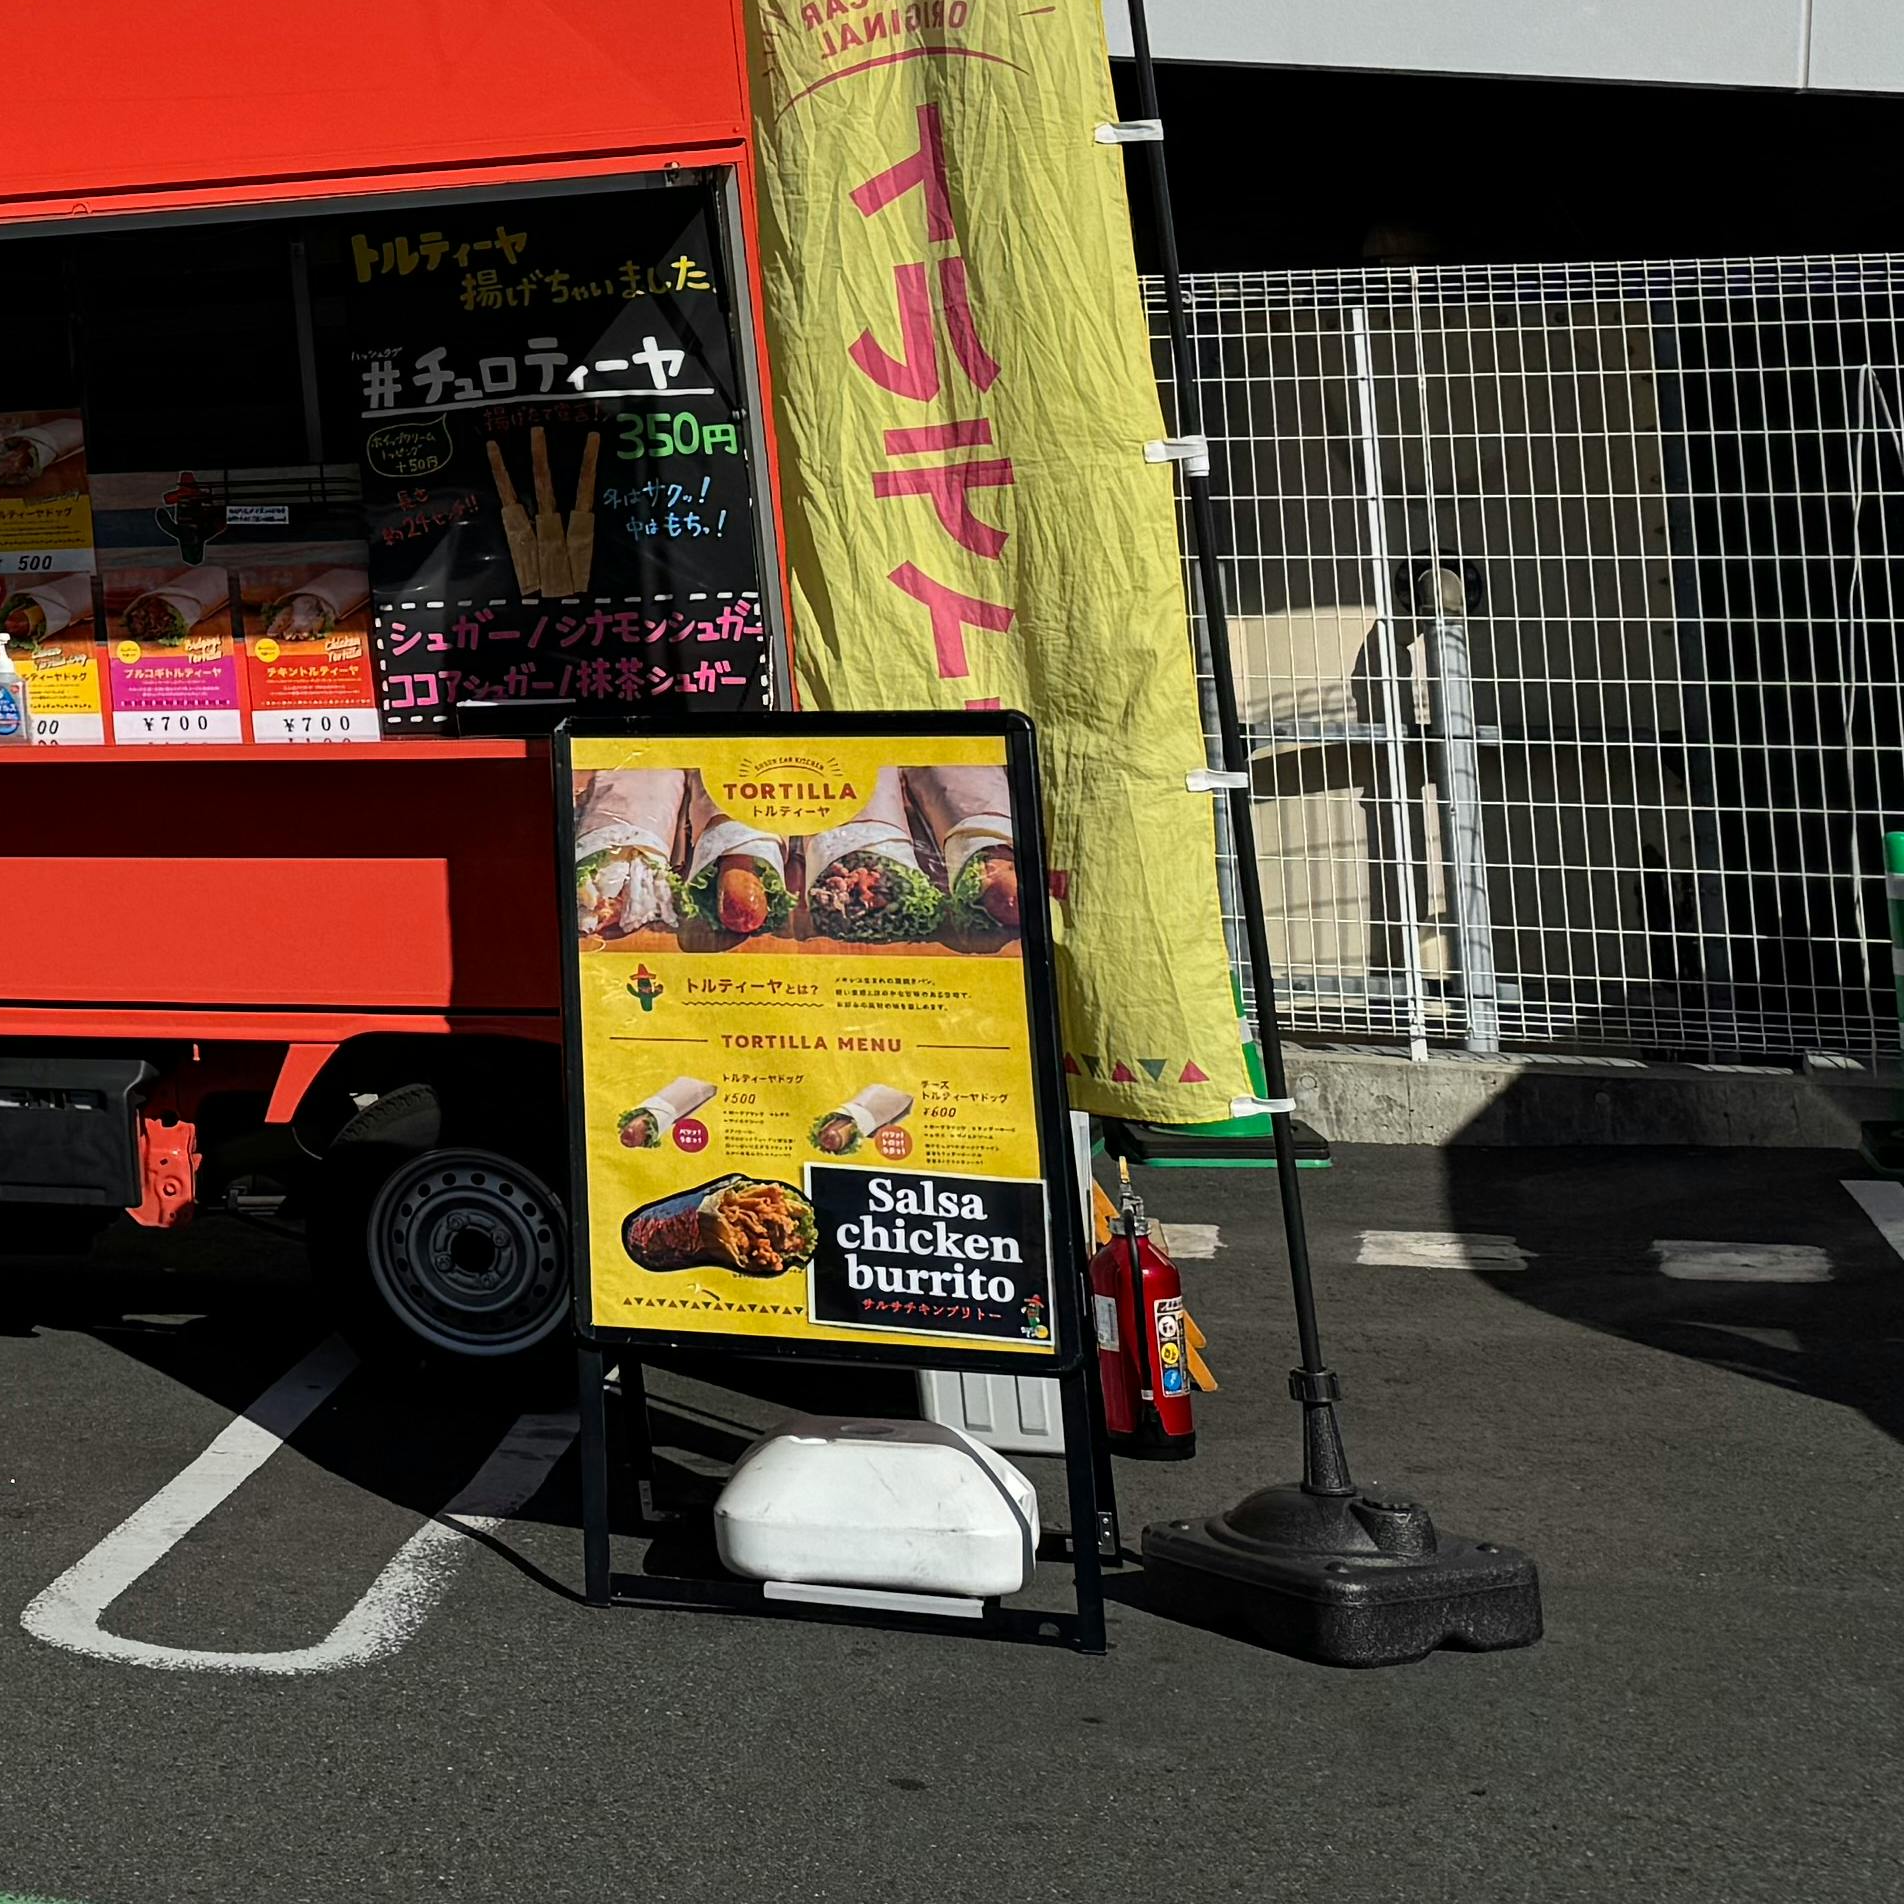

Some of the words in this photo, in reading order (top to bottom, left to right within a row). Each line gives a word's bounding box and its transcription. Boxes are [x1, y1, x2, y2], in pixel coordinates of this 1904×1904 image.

[351, 226, 527, 283] トルティーヤ
[617, 412, 738, 459] 350円
[143, 715, 208, 732] ¥700
[283, 715, 350, 732] ¥700
[723, 782, 857, 800] TORTILLA
[753, 805, 830, 817] トルティーヤ
[721, 1034, 828, 1050] TORTILLA
[838, 1036, 902, 1053] MENU
[723, 1073, 804, 1084] トルティーヤドッグ
[922, 1091, 1009, 1104] トルティーヤドッグ
[868, 1177, 988, 1221] Salsa
[836, 1215, 1023, 1263] chicken
[844, 1254, 1015, 1303] burrito
